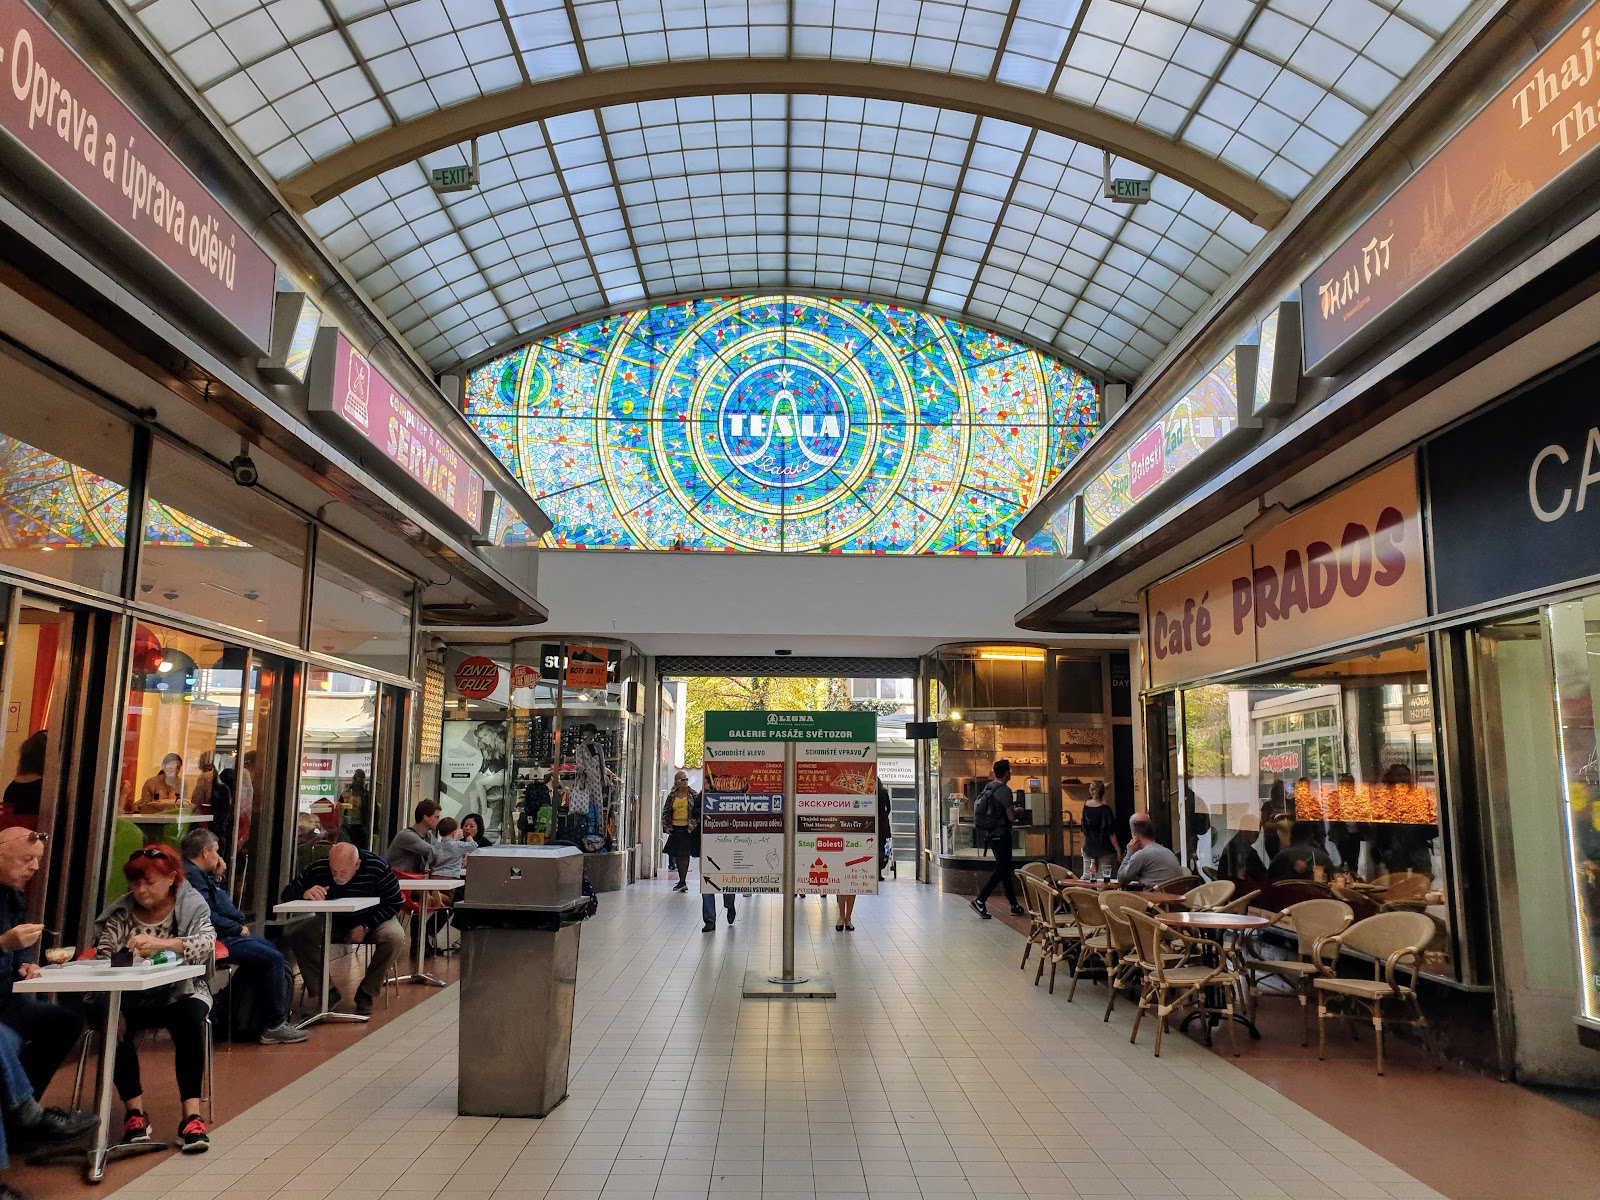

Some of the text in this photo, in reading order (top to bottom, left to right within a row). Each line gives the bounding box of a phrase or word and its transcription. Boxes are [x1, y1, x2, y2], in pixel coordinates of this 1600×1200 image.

[1551, 99, 1600, 156] Th
[11, 28, 237, 291] Oprava a úprava oděvů
[441, 168, 466, 186] EXIT
[1117, 180, 1141, 197] EXIT
[1318, 265, 1360, 320] THAI
[1361, 232, 1395, 285] FIT
[389, 393, 428, 438] computer
[727, 414, 841, 438] TESLA
[386, 416, 457, 508] SERVICE
[753, 455, 811, 476] Radio
[1130, 438, 1162, 485] Bolesti
[1153, 506, 1406, 660] Café PRADOS
[454, 664, 499, 677] SANTA
[457, 678, 493, 691] CRUZ
[728, 728, 853, 738] GALERIE PASÁŽE SVĚTOZOR
[714, 748, 745, 756] SCHODIŠTĚ
[805, 748, 837, 756] SCHODIŠTĚ
[718, 801, 769, 812] SERVICE
[798, 800, 851, 808] ЭКСКУРСИИ
[798, 840, 815, 848] Stop
[817, 840, 843, 848] Bolesti
